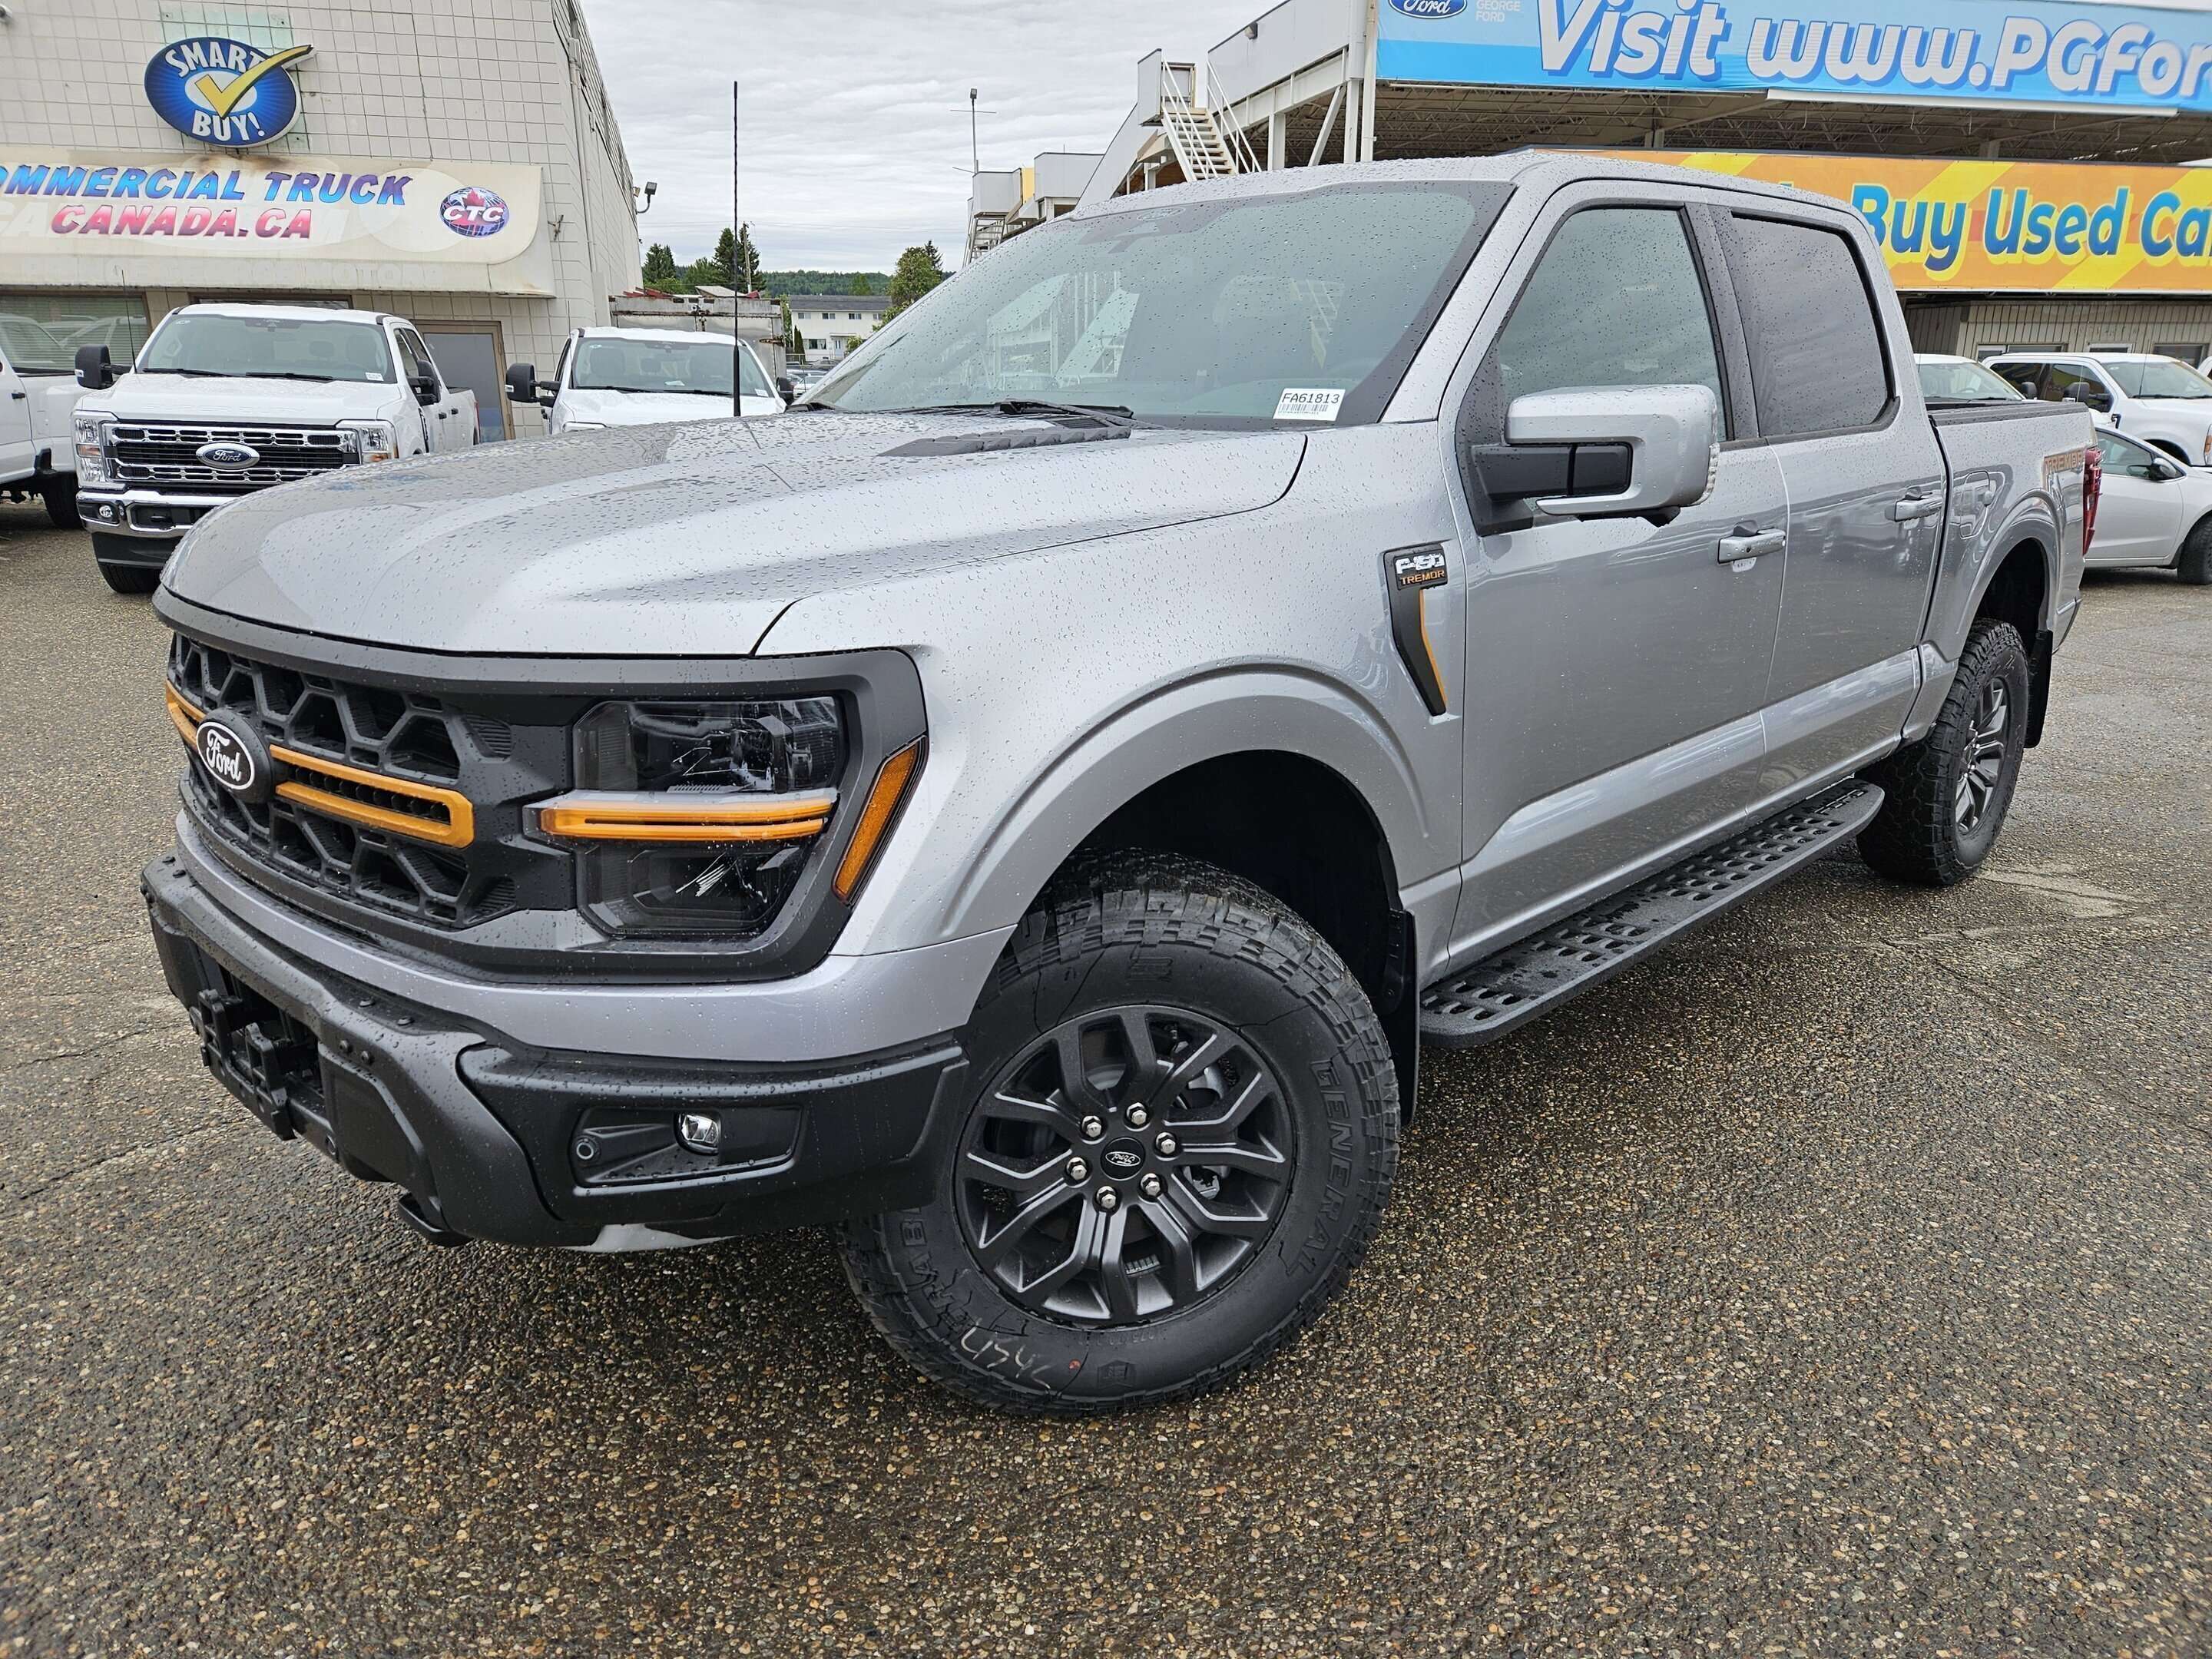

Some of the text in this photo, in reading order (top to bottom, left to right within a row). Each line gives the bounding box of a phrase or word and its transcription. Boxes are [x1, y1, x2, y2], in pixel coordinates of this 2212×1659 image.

[1475, 0, 1521, 12] GEORGE
[1475, 12, 1505, 22] FORD
[1537, 0, 1728, 78] Visit
[164, 41, 267, 78] SMART
[191, 109, 266, 142] BUY!
[0, 164, 413, 205] MMERCIAL TRUCK
[51, 204, 312, 239] CANADA.CA
[442, 204, 504, 223] CTC
[1851, 184, 1968, 272] Buy
[1985, 185, 2131, 257] Used
[1281, 392, 1340, 404] FA61813
[213, 449, 241, 462] Ford
[1395, 553, 1445, 575] F-150
[1400, 570, 1445, 584] TREMOR
[206, 729, 242, 782] Ford
[1111, 1153, 1136, 1165] Ford
